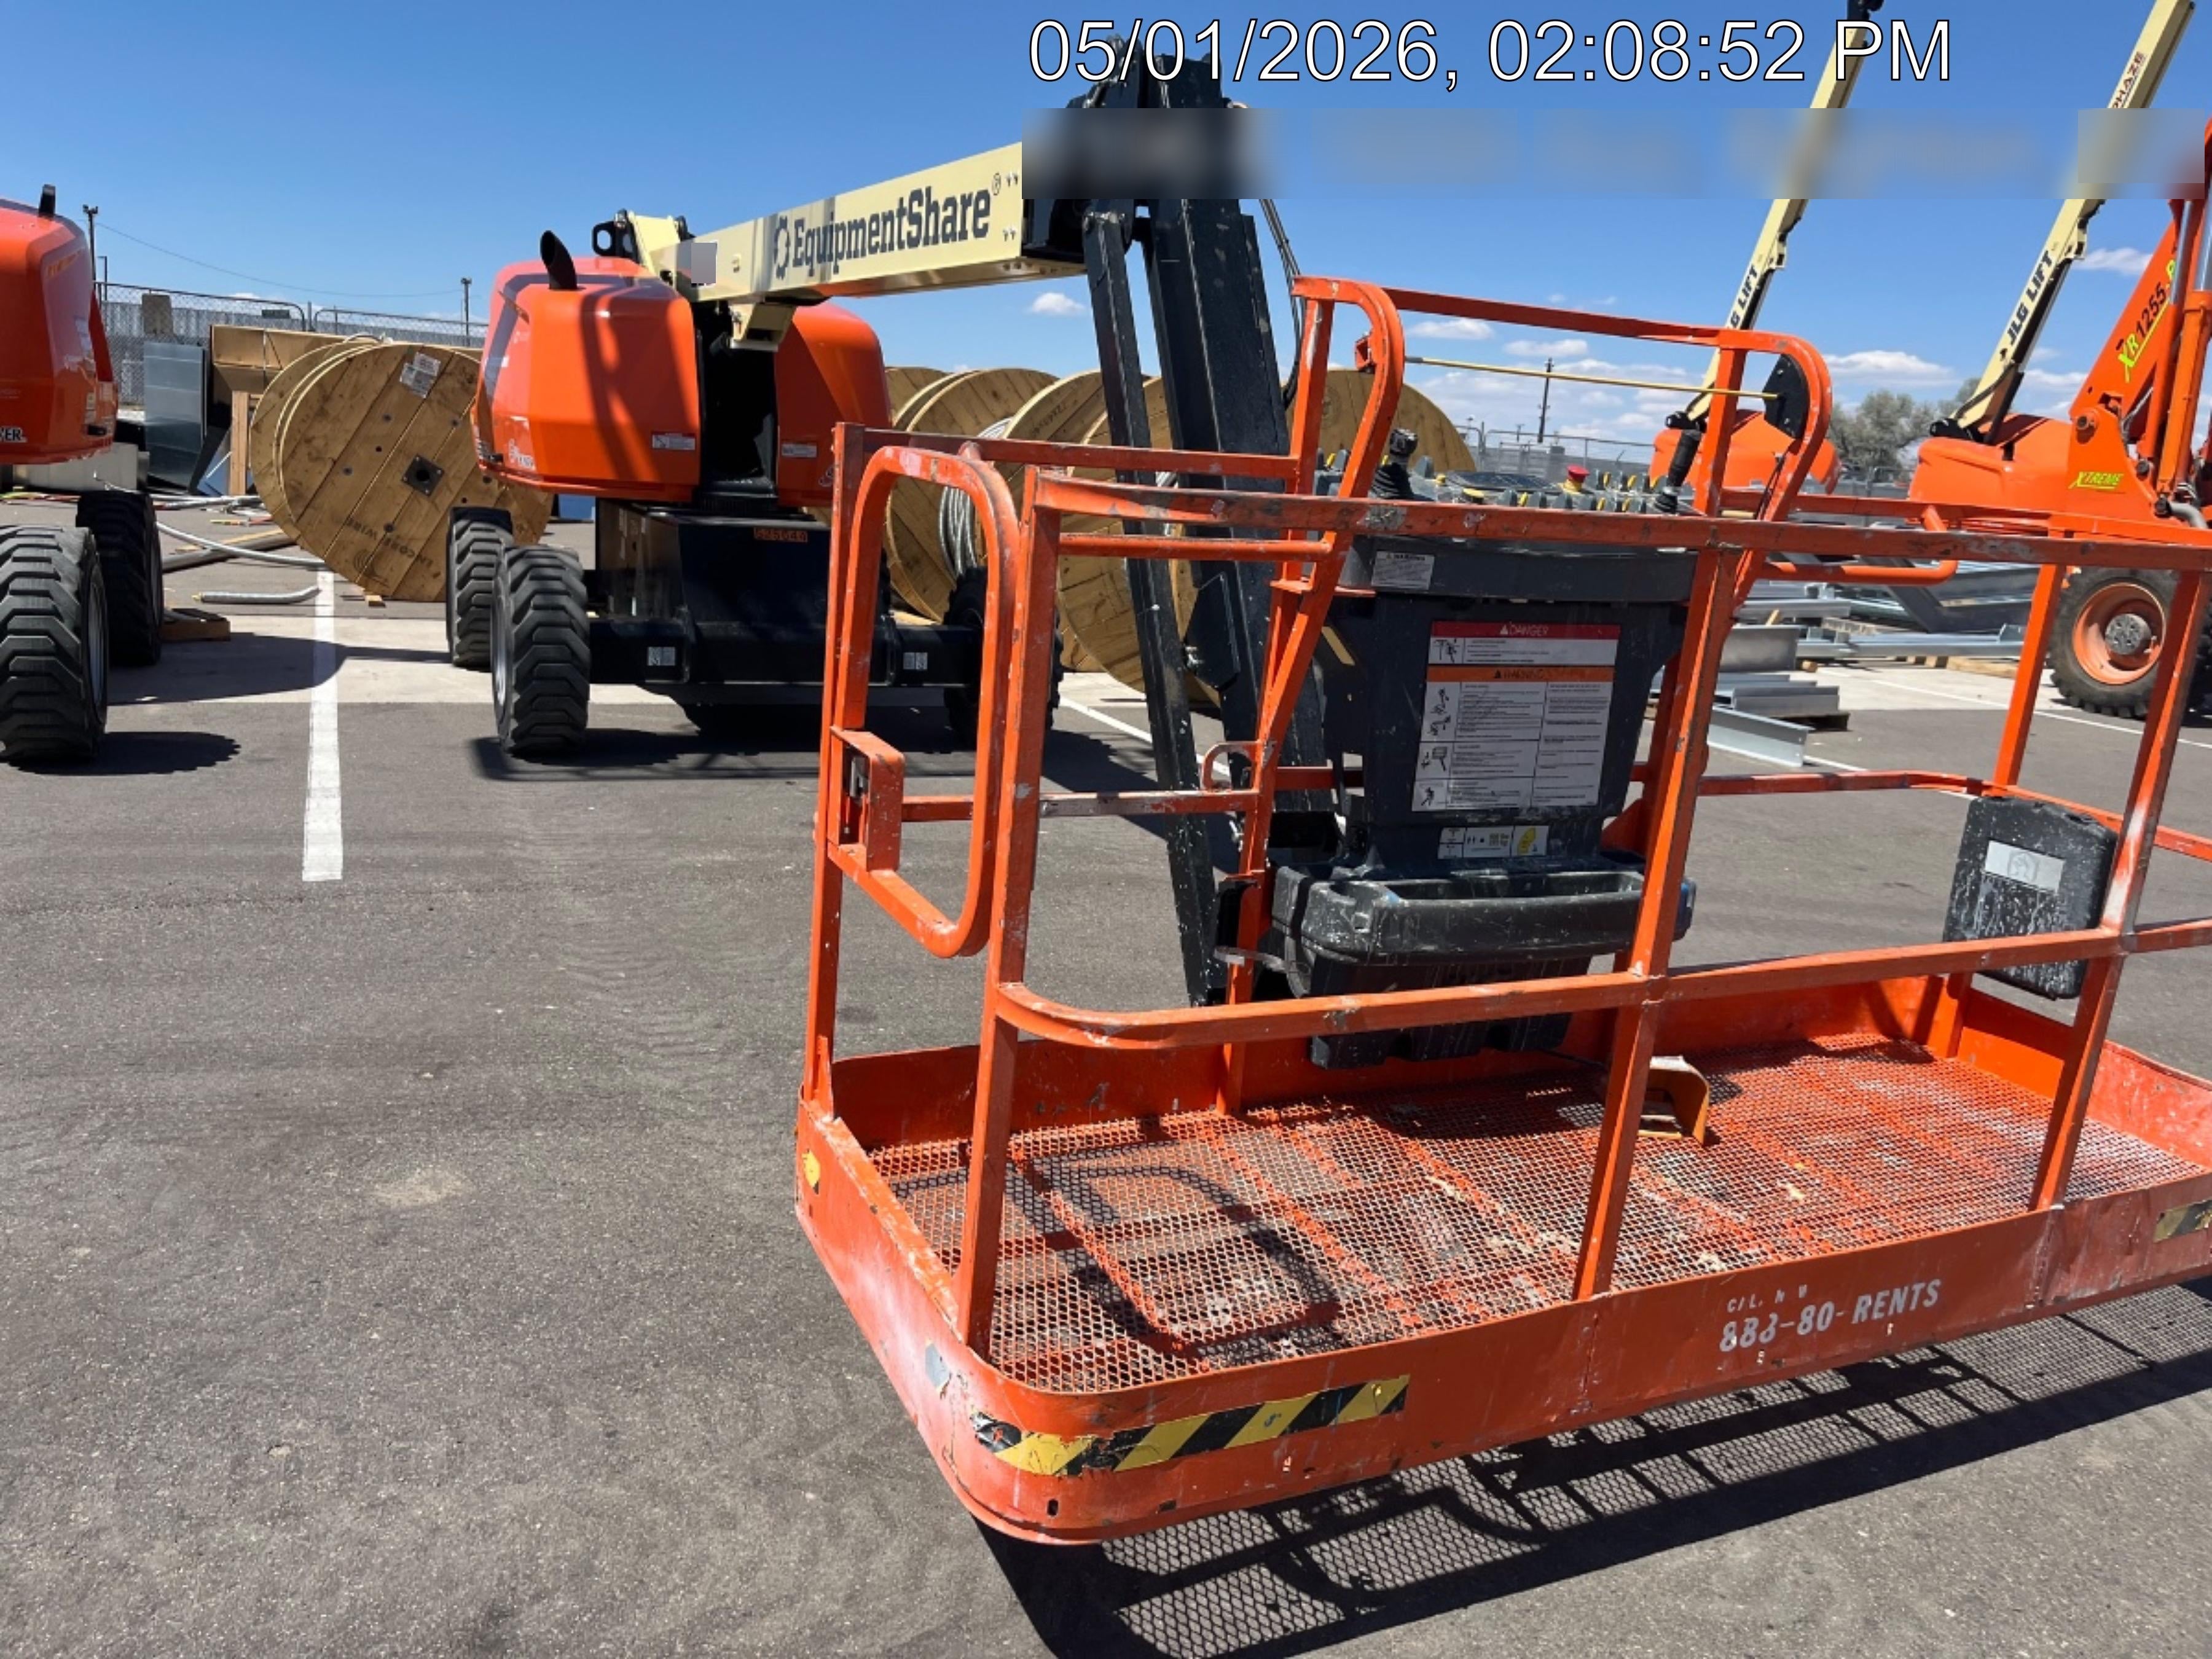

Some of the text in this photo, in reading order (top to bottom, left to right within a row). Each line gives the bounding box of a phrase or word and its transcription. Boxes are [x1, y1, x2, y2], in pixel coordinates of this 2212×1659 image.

[1738, 264, 1757, 310] LIFT
[2007, 250, 2052, 346] JLG LIFT
[2068, 471, 2124, 489] XTREME
